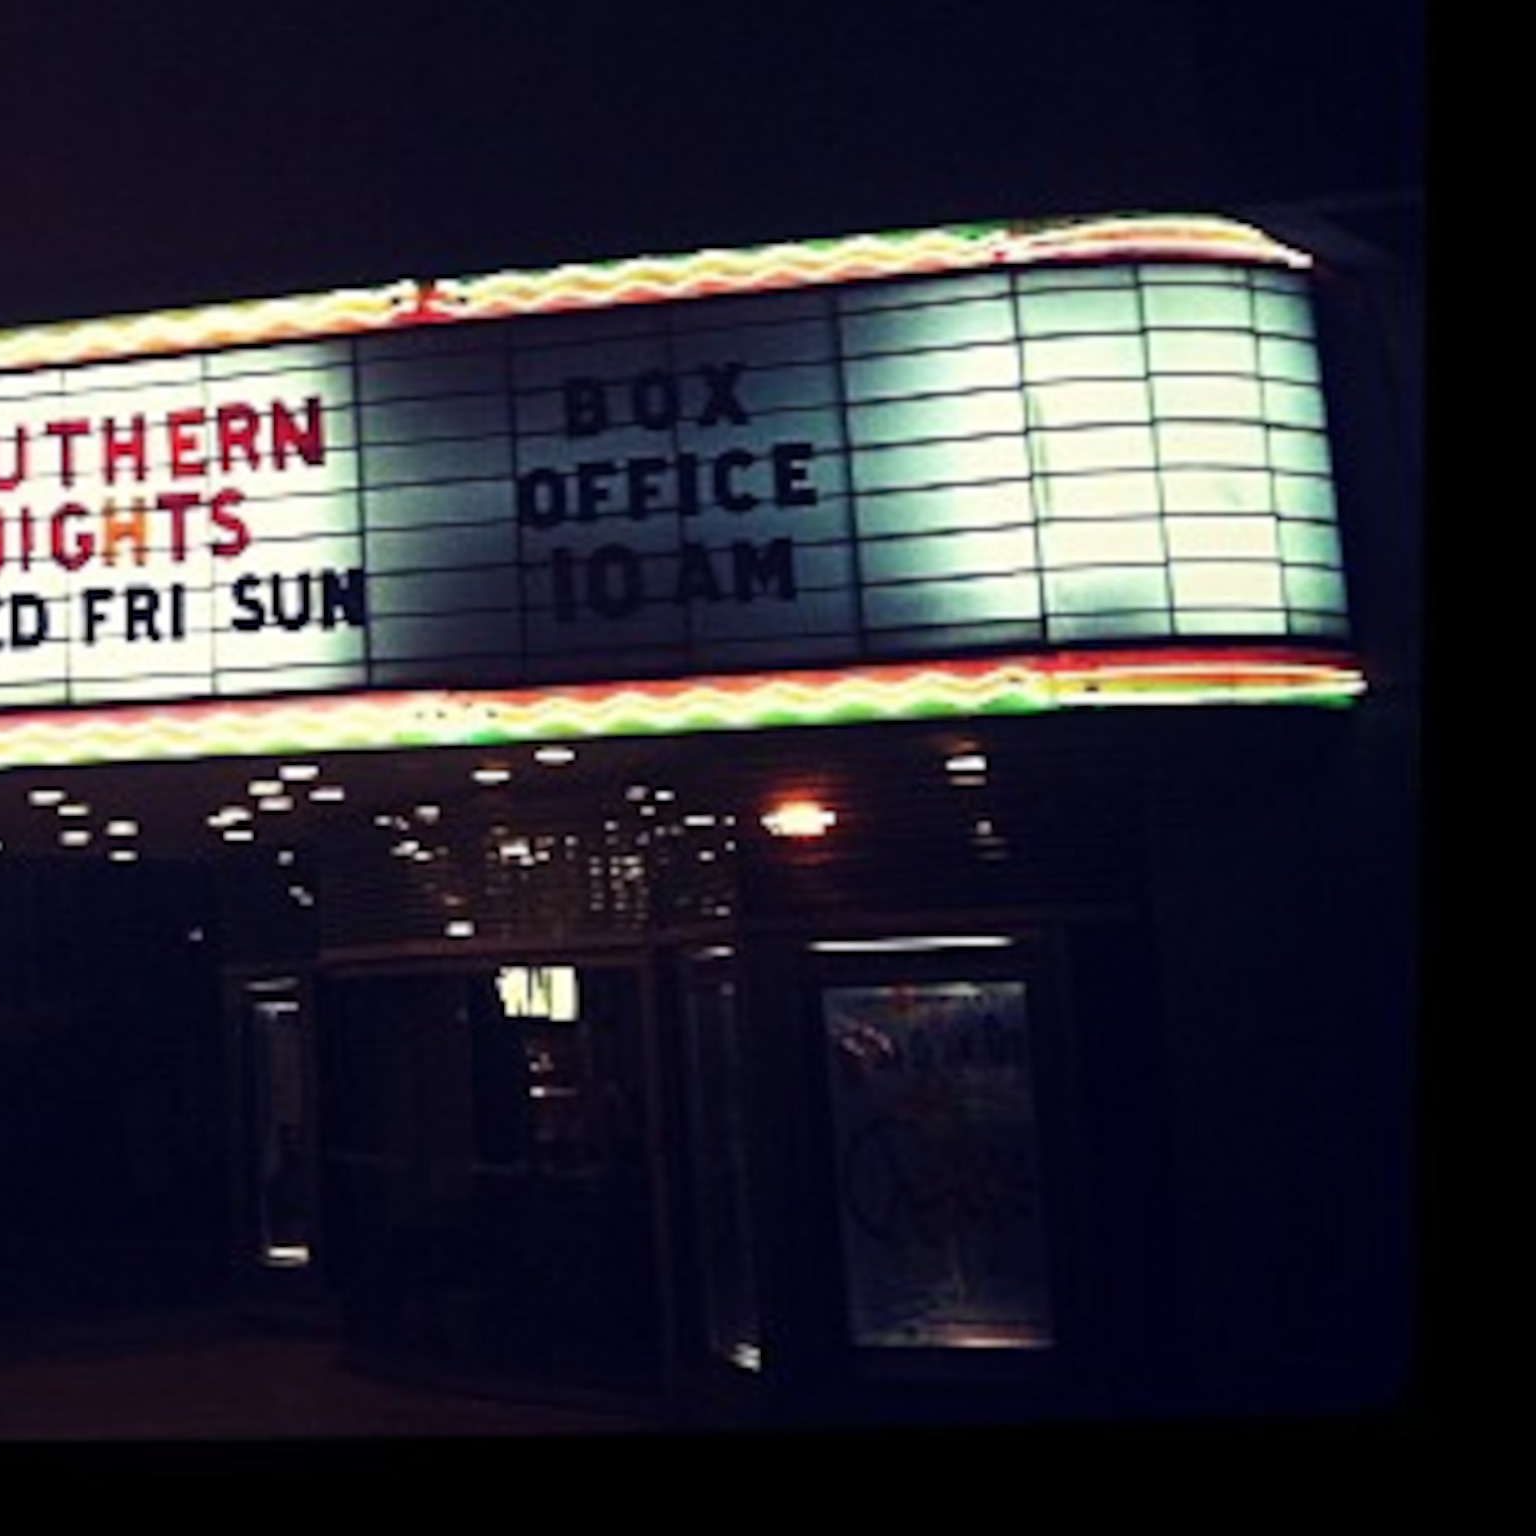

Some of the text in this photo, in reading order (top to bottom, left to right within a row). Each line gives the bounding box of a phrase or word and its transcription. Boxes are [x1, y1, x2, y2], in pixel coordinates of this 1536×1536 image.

[566, 363, 749, 437] BOX
[518, 442, 817, 528] OFFICE
[80, 583, 186, 645] FRI
[230, 566, 367, 632] SUN
[552, 537, 797, 623] 10 AM
